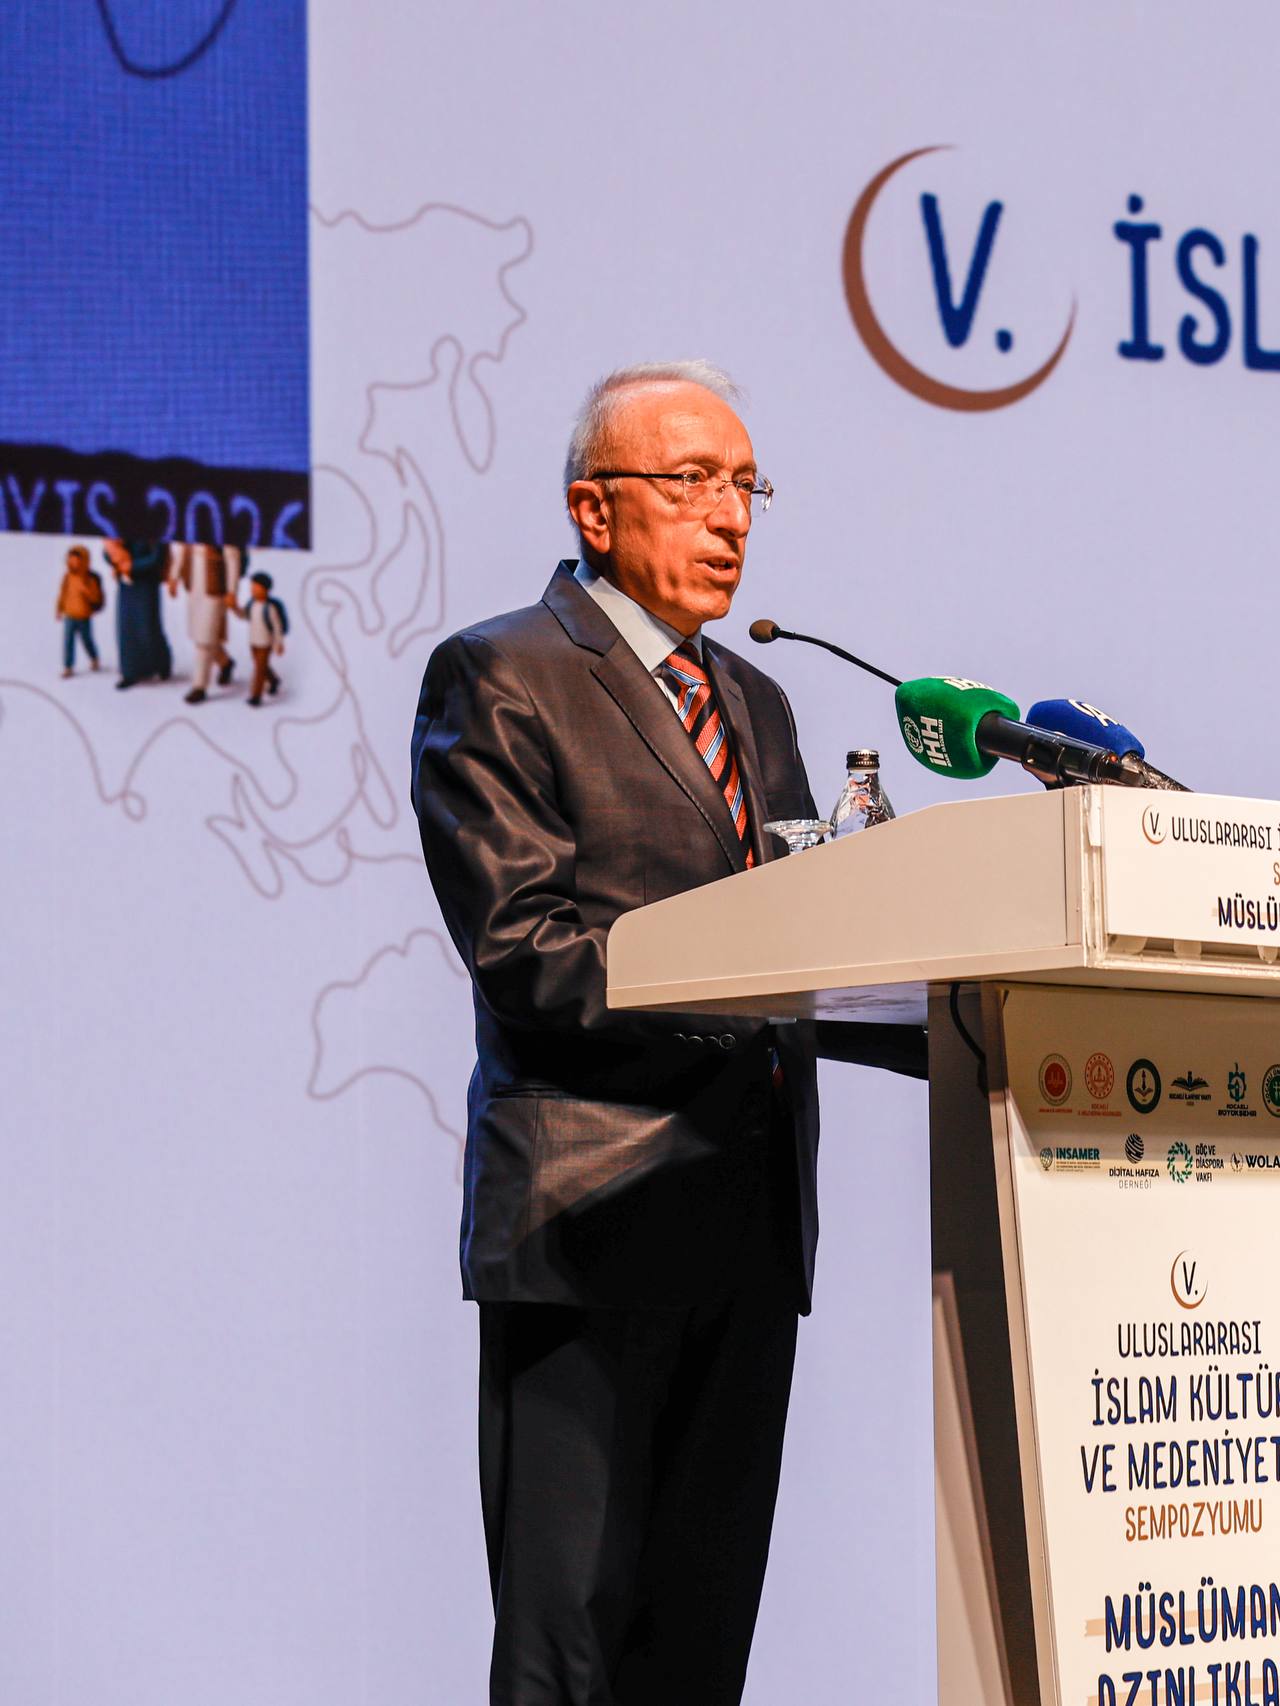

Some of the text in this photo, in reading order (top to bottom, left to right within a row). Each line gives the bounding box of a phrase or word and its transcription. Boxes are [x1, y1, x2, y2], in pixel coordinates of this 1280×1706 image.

[920, 192, 1013, 353] V.
[1149, 811, 1161, 836] V.
[1171, 816, 1272, 851] ULUSLARARASI
[1196, 1172, 1212, 1182] VAKFI
[1183, 1261, 1198, 1295] V.
[1118, 1320, 1262, 1358] ULUSLARARASI
[1091, 1368, 1177, 1425] İSLAM
[1080, 1444, 1117, 1493] VE
[1125, 1498, 1263, 1542] SEMPOZYUMU
